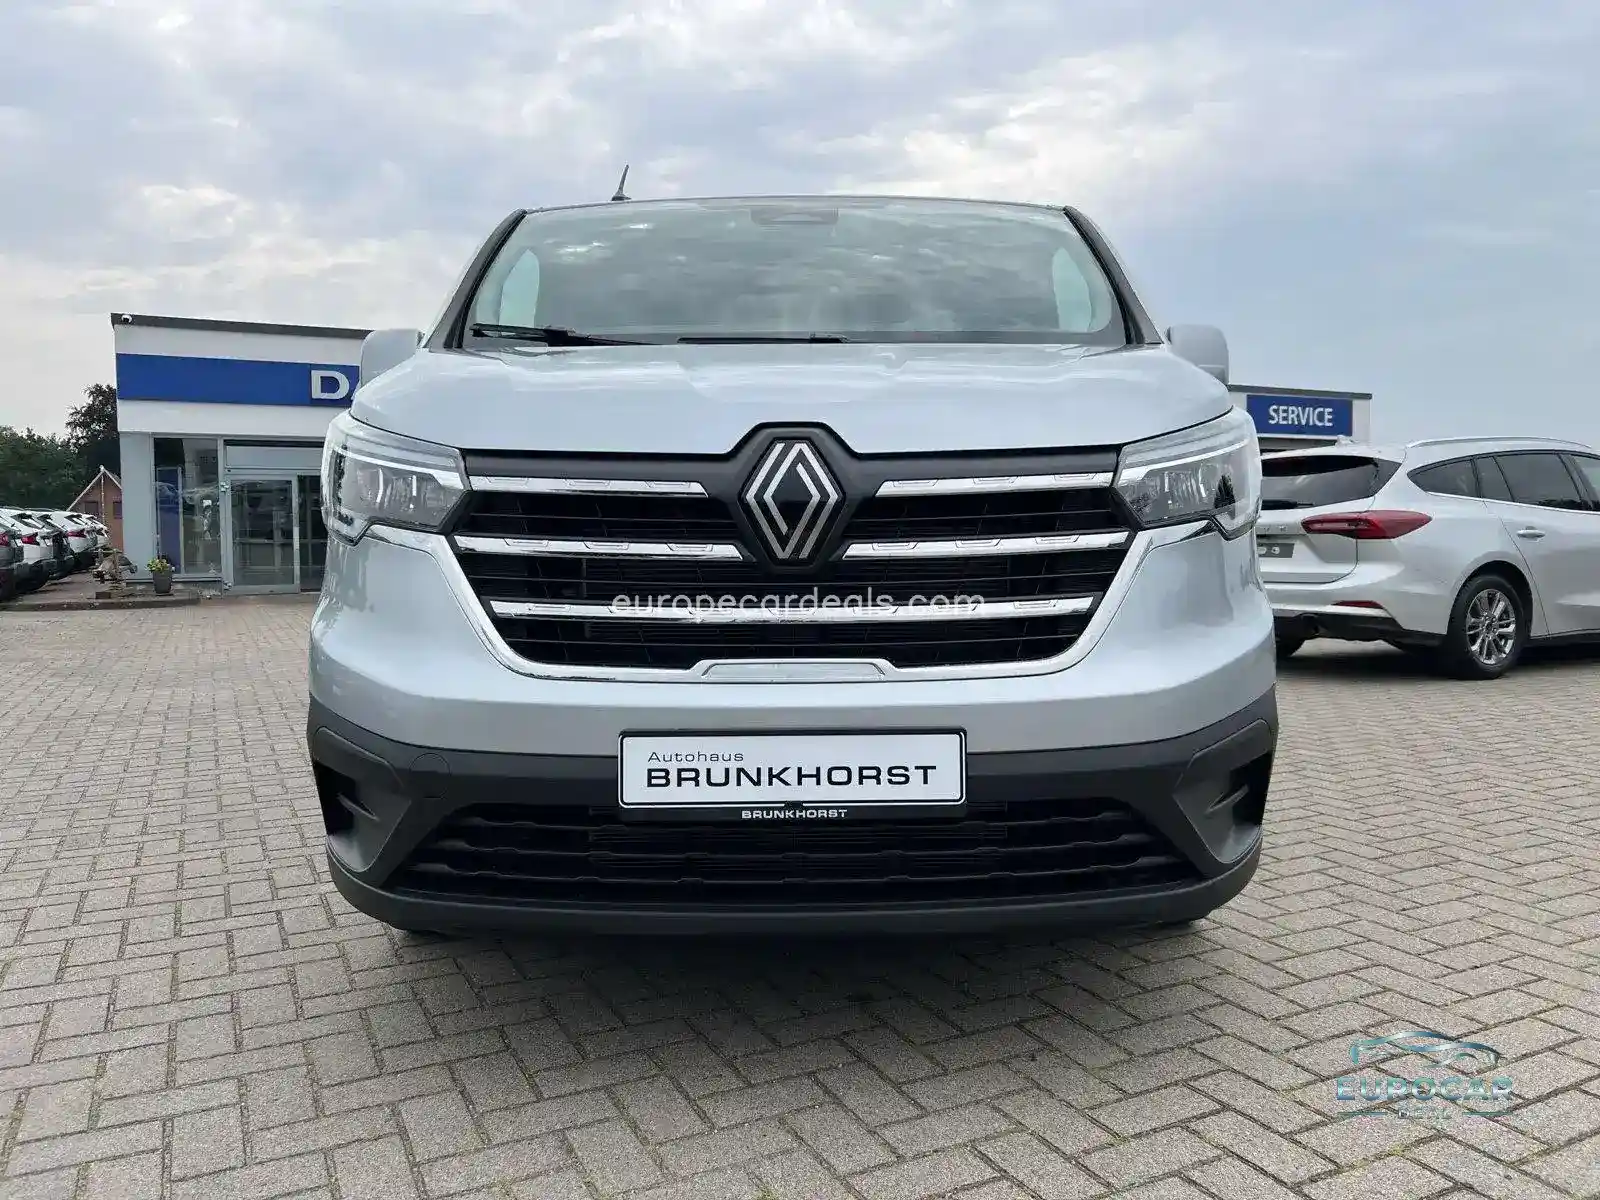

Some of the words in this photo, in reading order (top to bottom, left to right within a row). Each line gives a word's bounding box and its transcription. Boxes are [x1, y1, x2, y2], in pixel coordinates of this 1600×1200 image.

[311, 370, 360, 400] D
[1268, 405, 1334, 426] SERVICE
[648, 751, 744, 763] Autohaus
[646, 765, 937, 788] BRUNKHORST
[741, 809, 848, 819] BRUNKHORST
